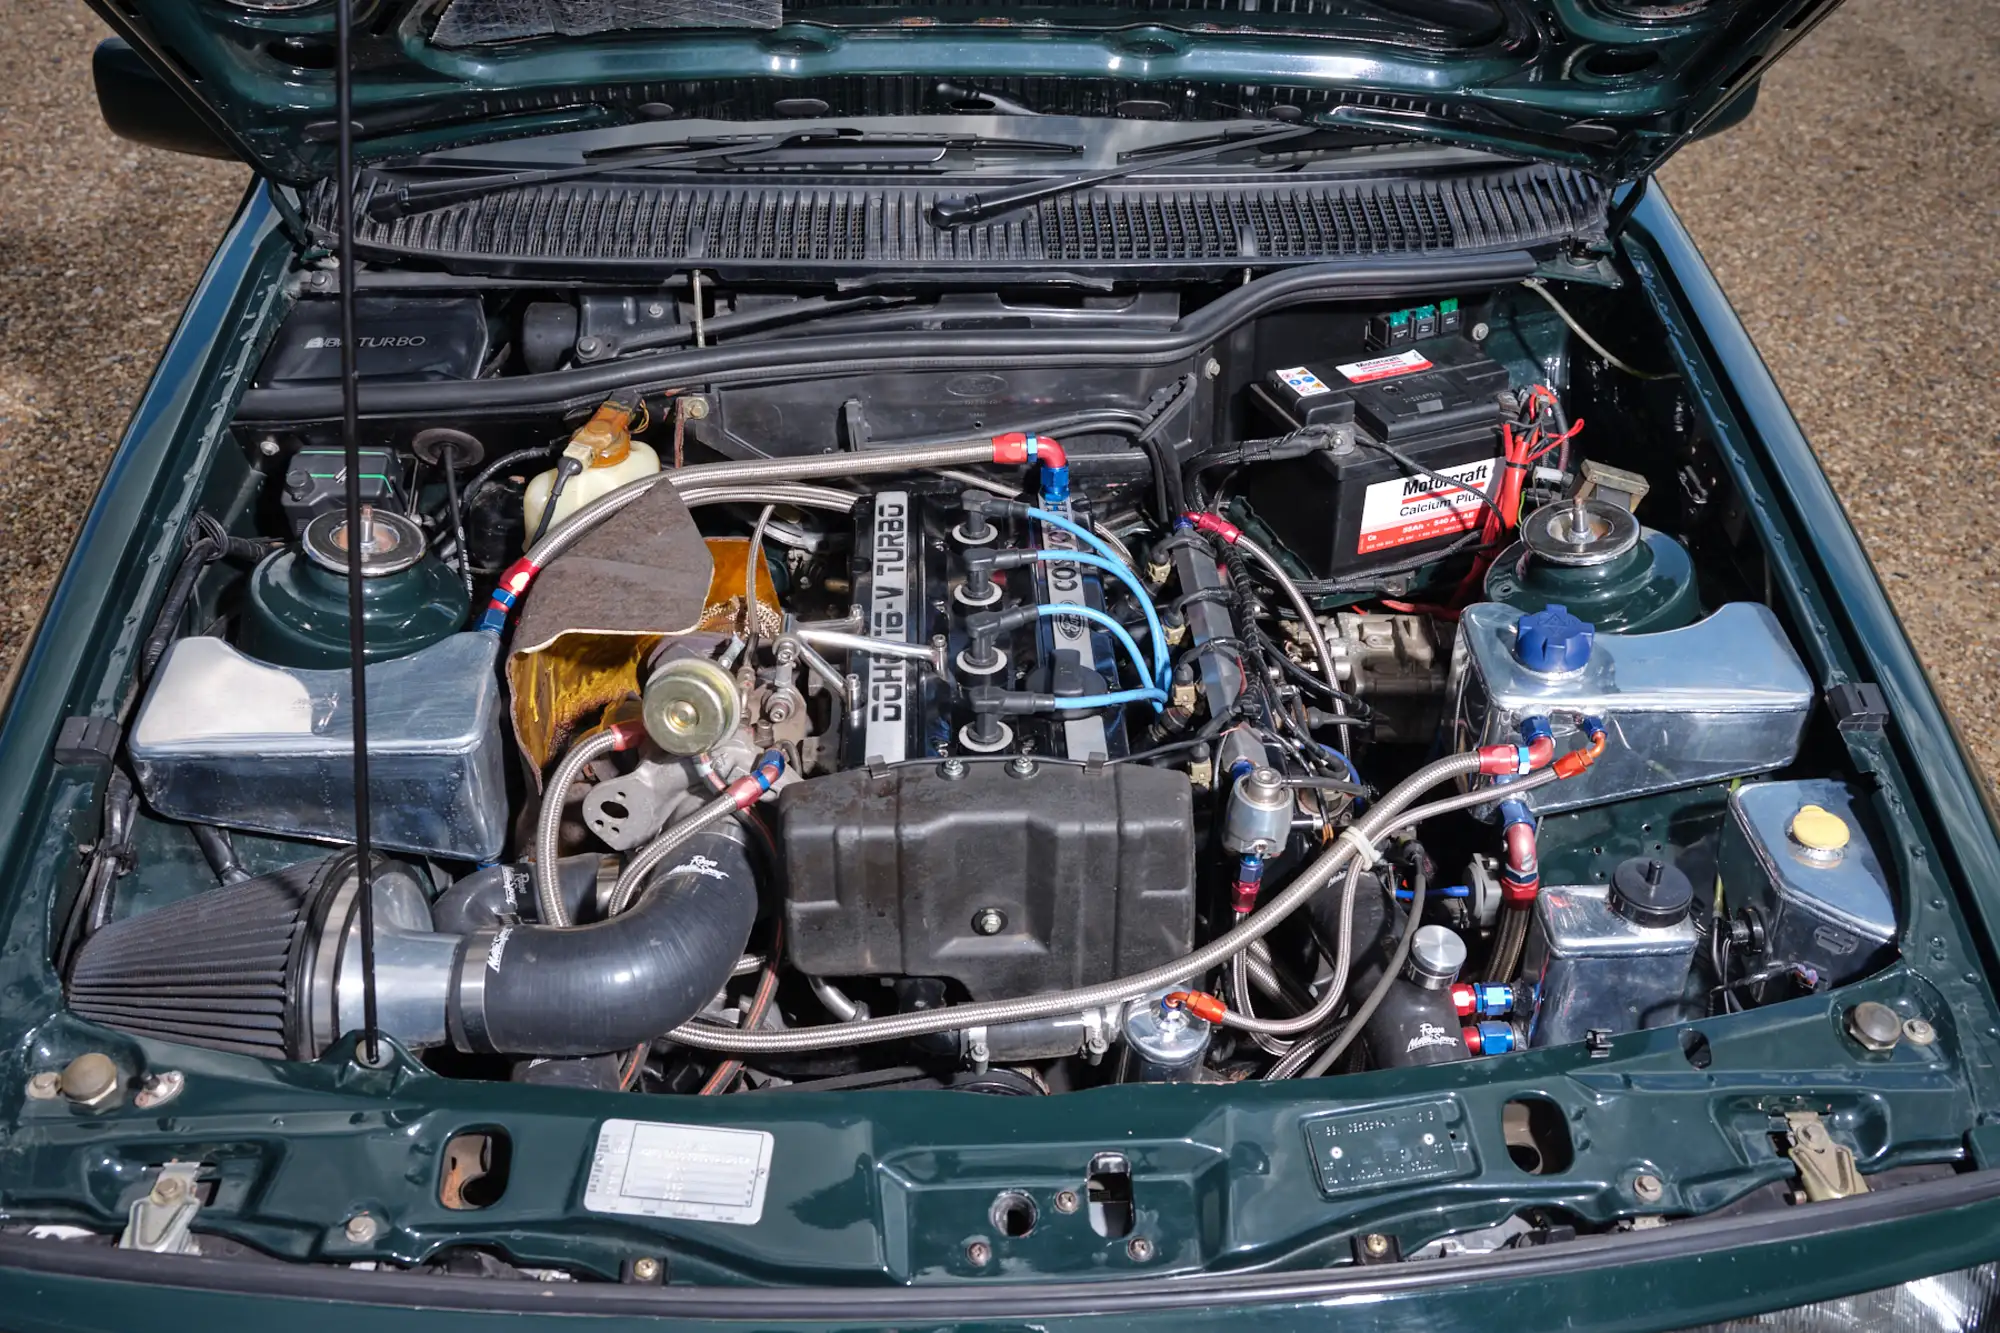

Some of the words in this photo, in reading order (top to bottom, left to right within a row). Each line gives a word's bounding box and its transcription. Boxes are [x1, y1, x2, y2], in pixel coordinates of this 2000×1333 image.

[358, 336, 426, 348] TURBO
[1400, 499, 1451, 517] Calcium
[875, 503, 905, 576] TURBO
[874, 586, 904, 637] 16-V
